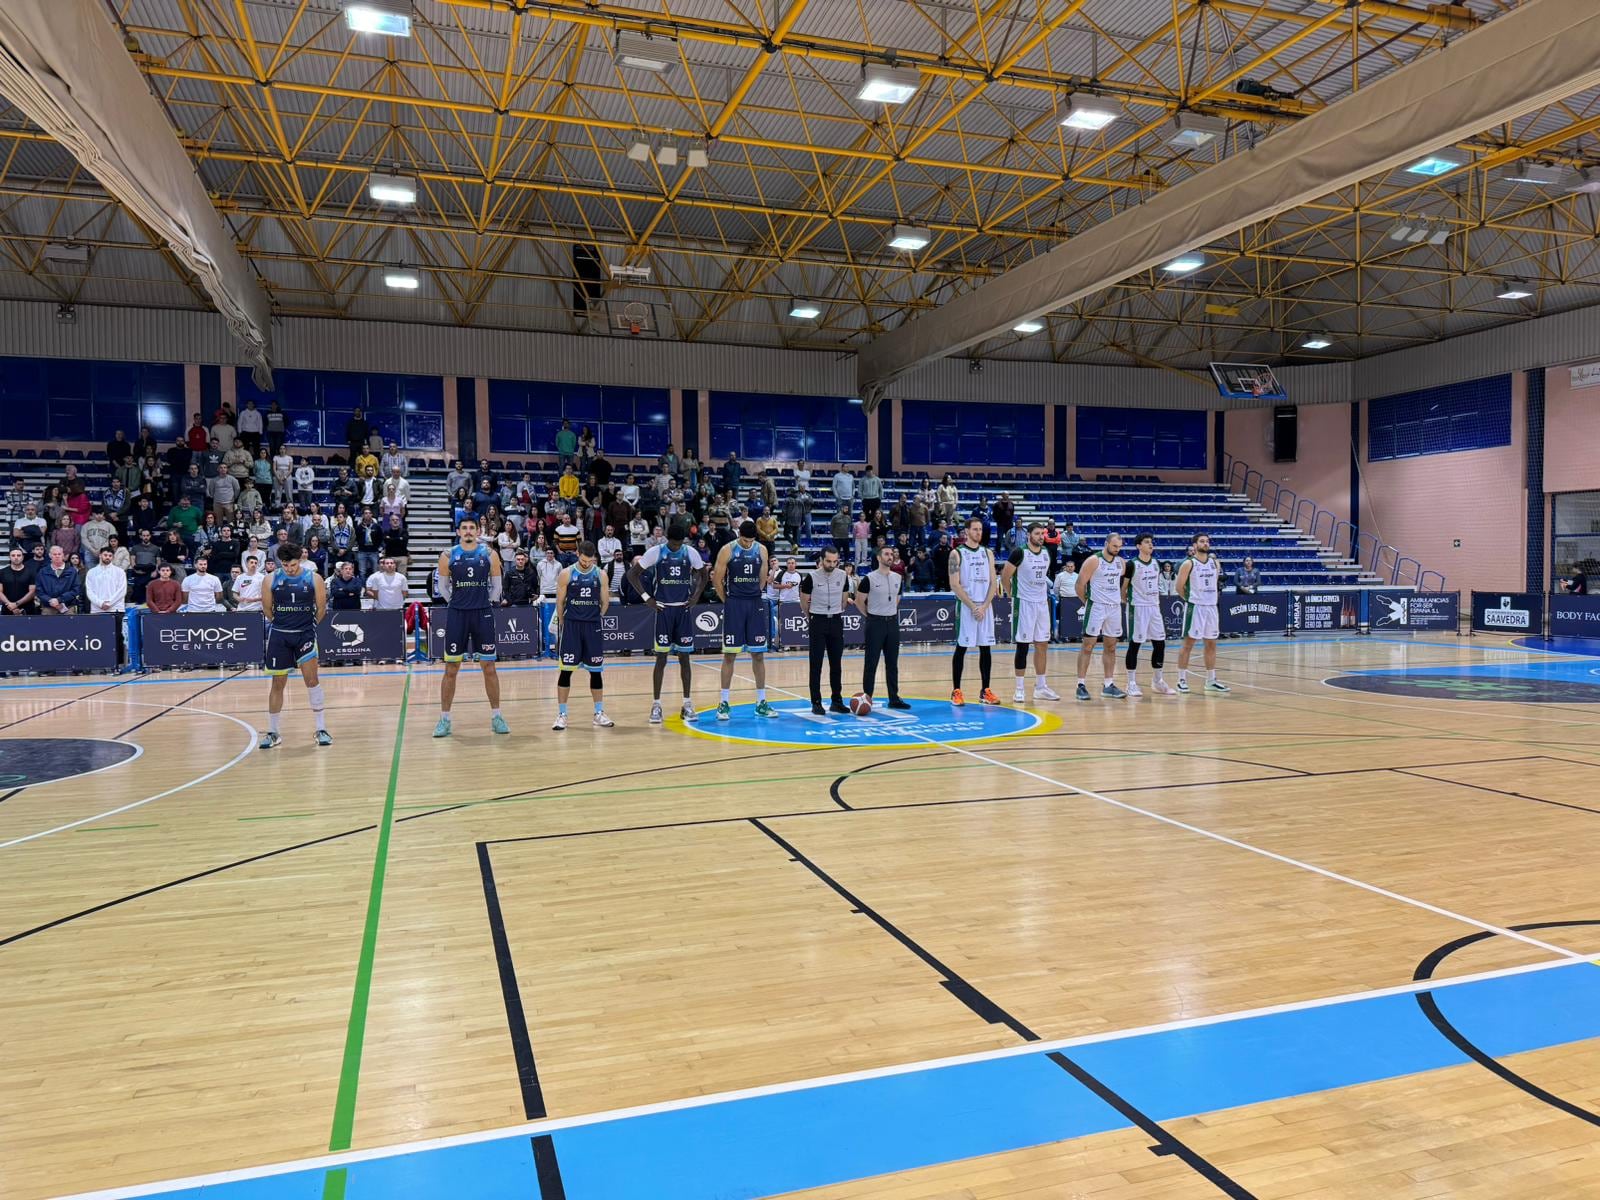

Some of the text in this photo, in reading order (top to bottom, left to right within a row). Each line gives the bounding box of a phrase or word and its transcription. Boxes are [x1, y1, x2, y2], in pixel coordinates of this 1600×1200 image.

[467, 567, 474, 577] 3
[670, 567, 681, 576] 35
[744, 564, 753, 574] 21
[290, 592, 296, 603] 1
[580, 588, 591, 597] 22
[1293, 601, 1302, 629] AMBAR
[1486, 614, 1527, 625] SAAVEDRA
[1556, 611, 1583, 620] BODY
[498, 633, 530, 641] LABOR
[603, 632, 635, 641] SORES
[659, 634, 669, 644] 35
[725, 635, 735, 645] 21
[0, 634, 102, 652] damex.io
[171, 642, 234, 651] CENTER
[450, 642, 457, 653] 3
[271, 657, 277, 667] 1
[563, 653, 575, 663] 22
